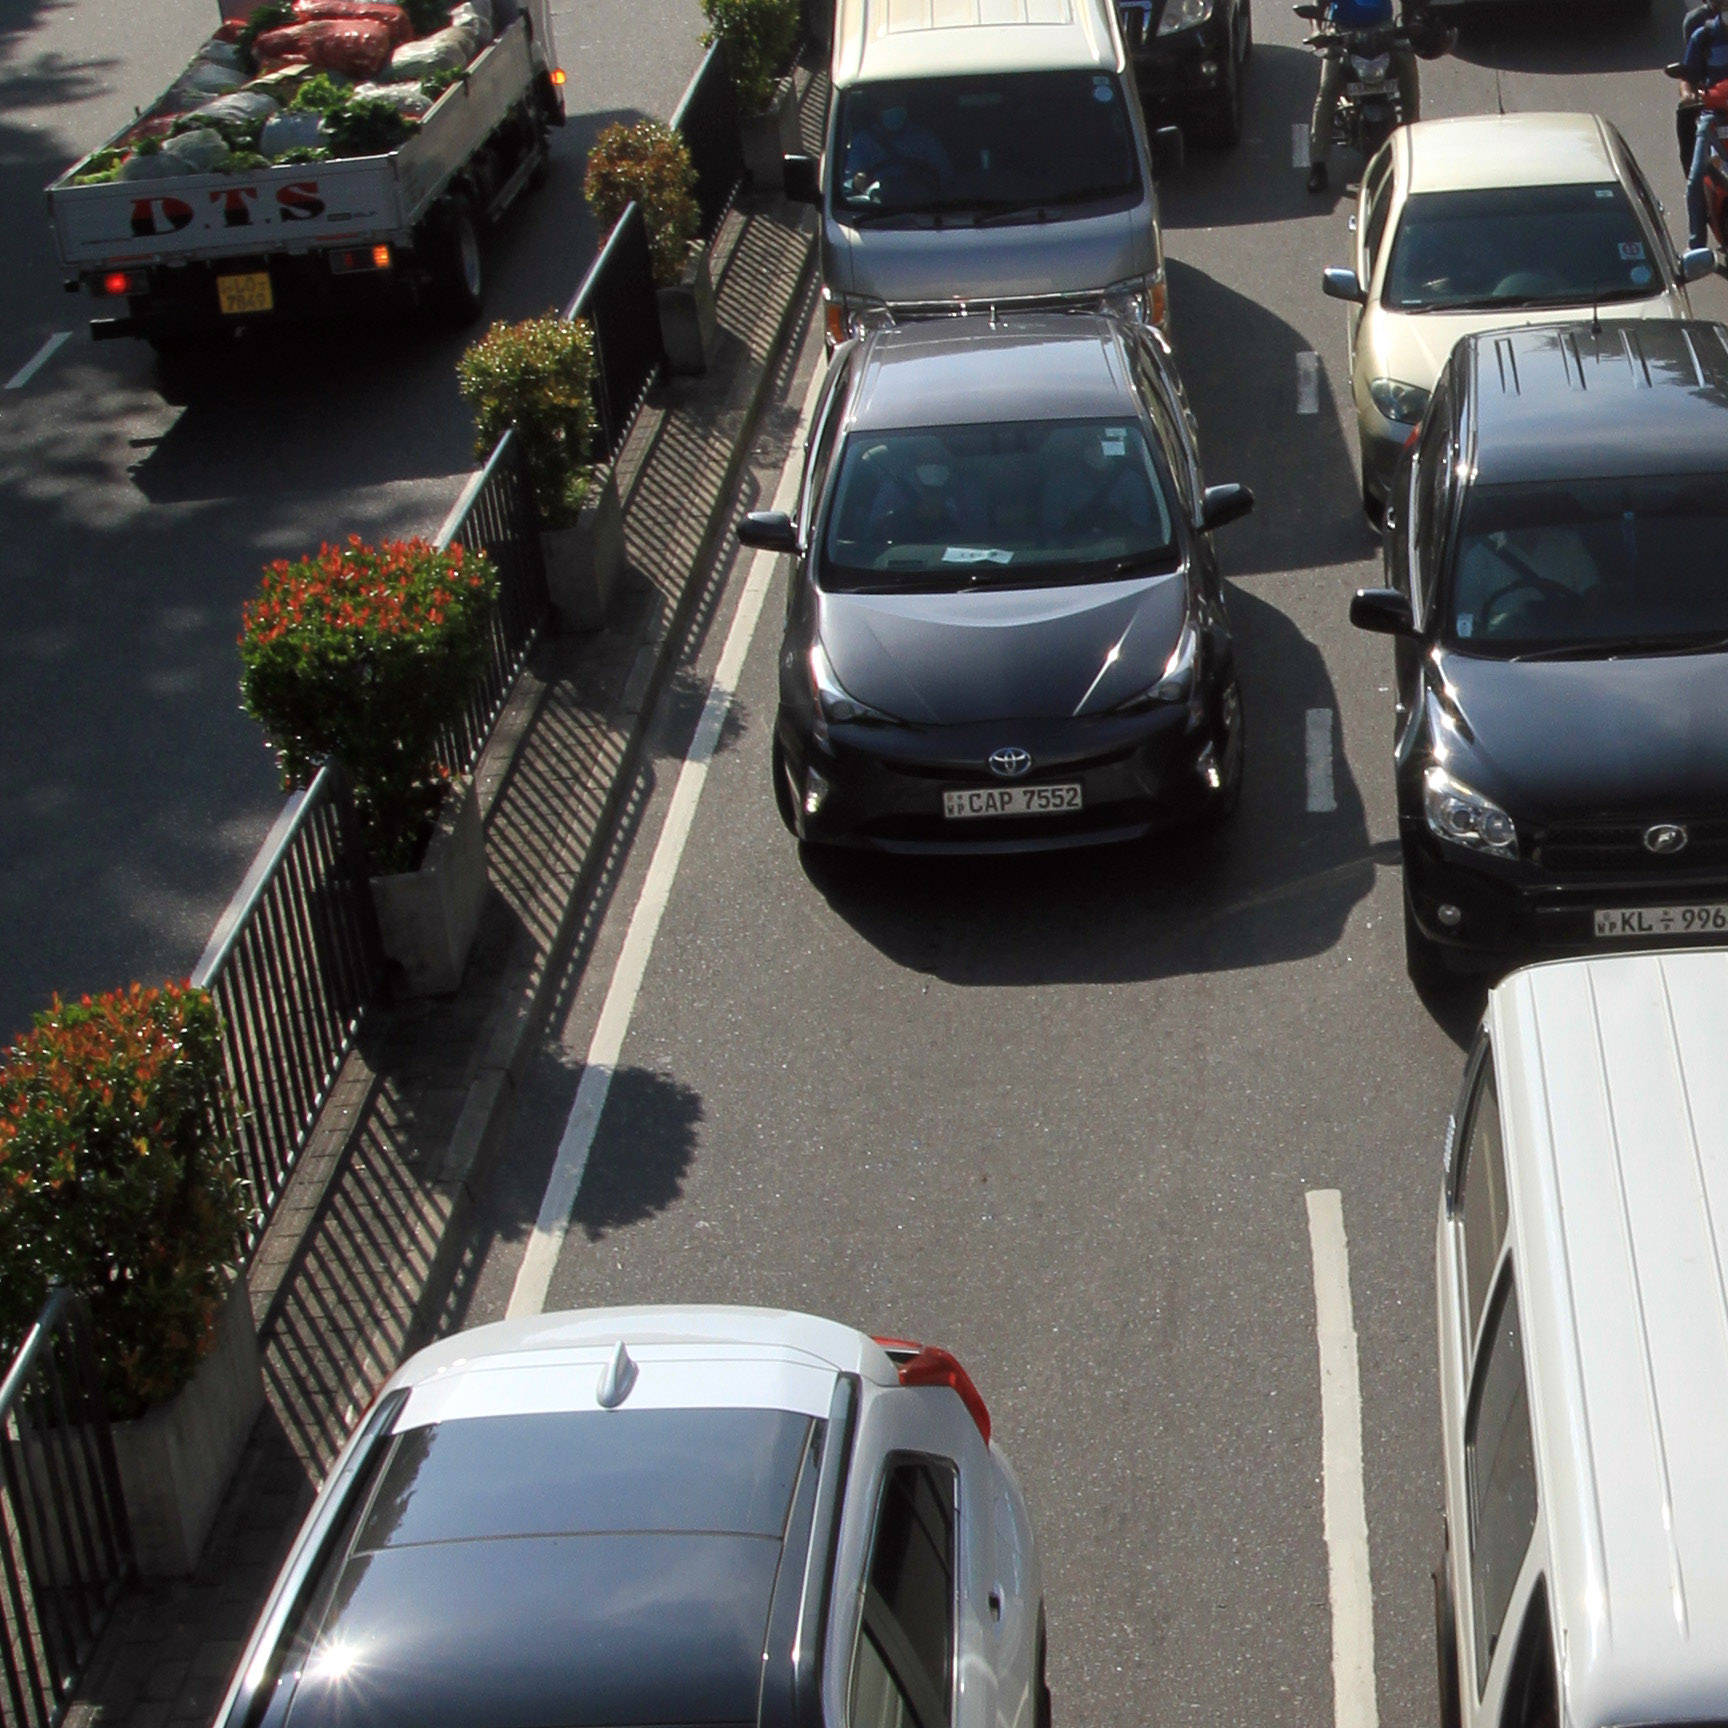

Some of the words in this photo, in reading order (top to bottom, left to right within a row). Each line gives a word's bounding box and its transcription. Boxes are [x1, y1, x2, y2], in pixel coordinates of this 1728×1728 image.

[969, 791, 1013, 814] CAP
[1023, 787, 1079, 810] 7552
[1621, 912, 1653, 933] KL
